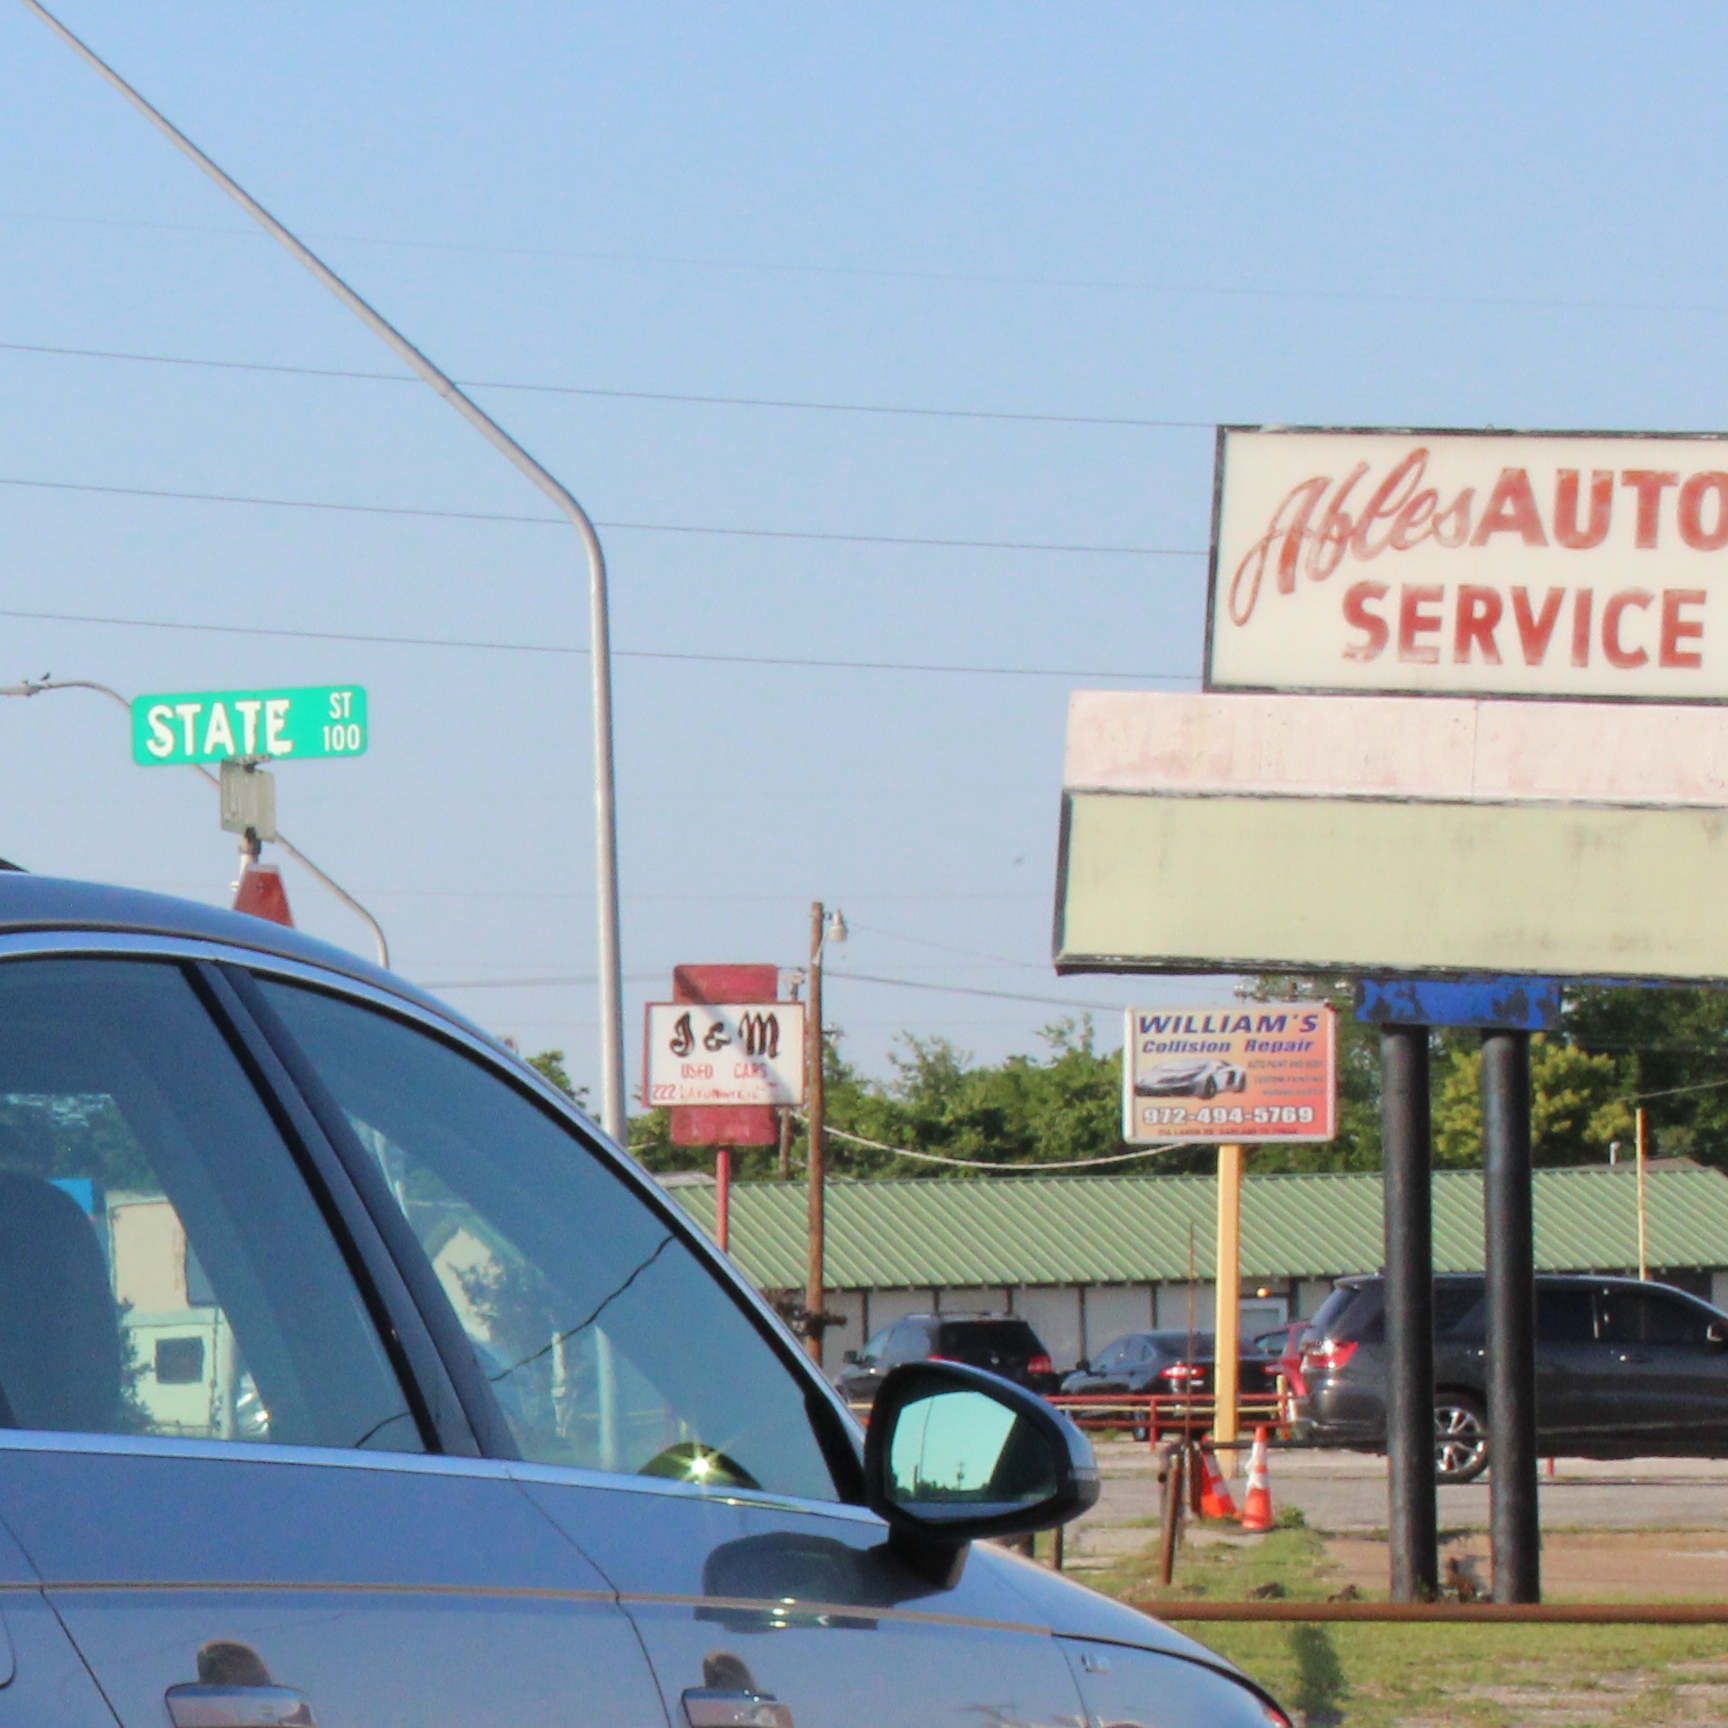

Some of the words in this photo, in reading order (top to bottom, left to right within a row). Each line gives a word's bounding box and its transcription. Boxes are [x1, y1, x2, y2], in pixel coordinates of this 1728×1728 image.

[1228, 446, 1476, 628] Ables
[1470, 467, 1728, 551] AUTO
[1341, 580, 1707, 669] SERVICE
[146, 699, 293, 758] STATE
[329, 691, 353, 720] ST
[323, 723, 361, 752] 100
[704, 1021, 732, 1052] &
[738, 1010, 780, 1059] M
[1138, 1014, 1319, 1034] WILLIAM'S
[1142, 1039, 1231, 1053] Collision
[1243, 1038, 1313, 1054] Repair
[681, 1064, 713, 1079] USED
[733, 1063, 768, 1078] CARS
[653, 1084, 676, 1100] 222
[1144, 1105, 1314, 1125] 972-494-5769
